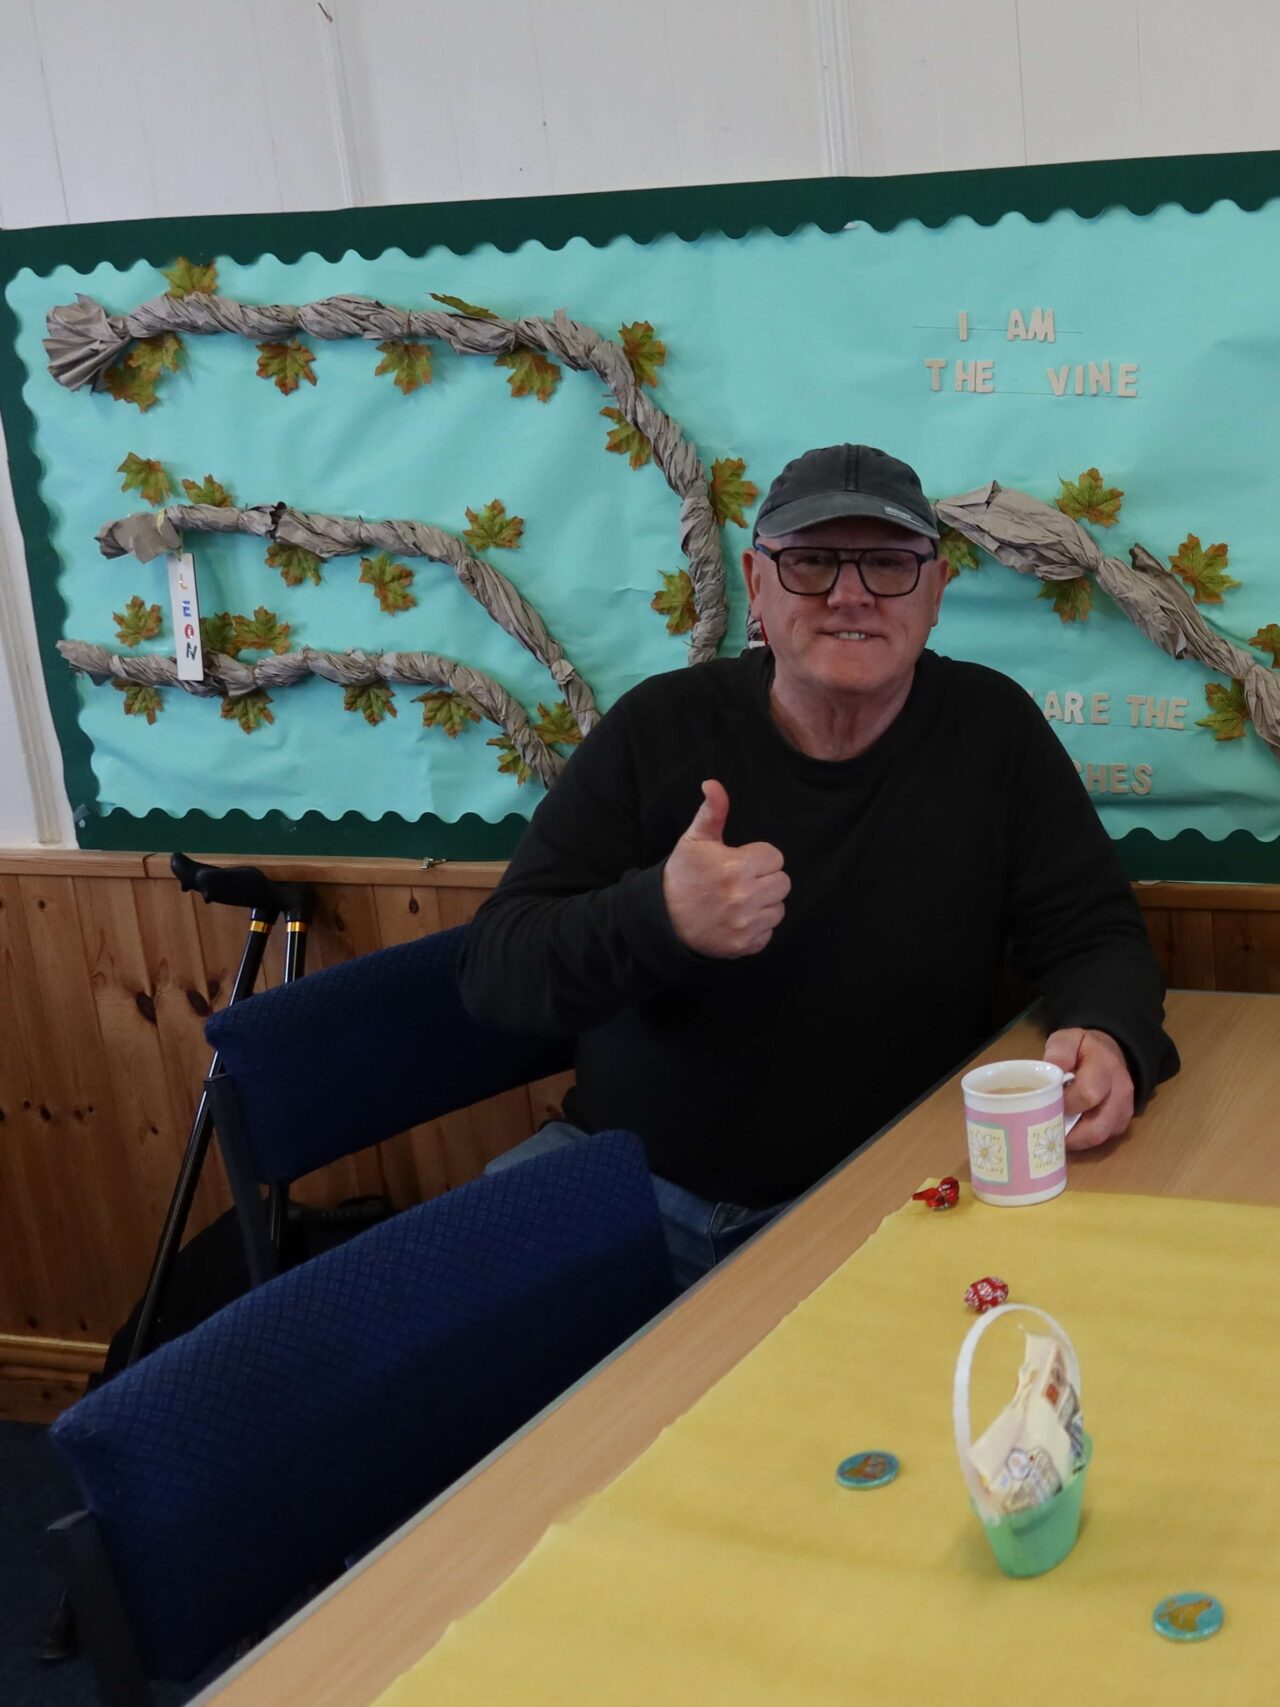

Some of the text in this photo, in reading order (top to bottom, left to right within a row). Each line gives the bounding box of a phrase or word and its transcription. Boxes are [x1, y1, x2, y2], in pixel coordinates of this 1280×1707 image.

[958, 307, 1056, 343] I AM
[925, 358, 1139, 398] THE VINE
[179, 573, 198, 660] LEON
[1044, 691, 1188, 731] ARE THE
[1073, 759, 1153, 796] HES
